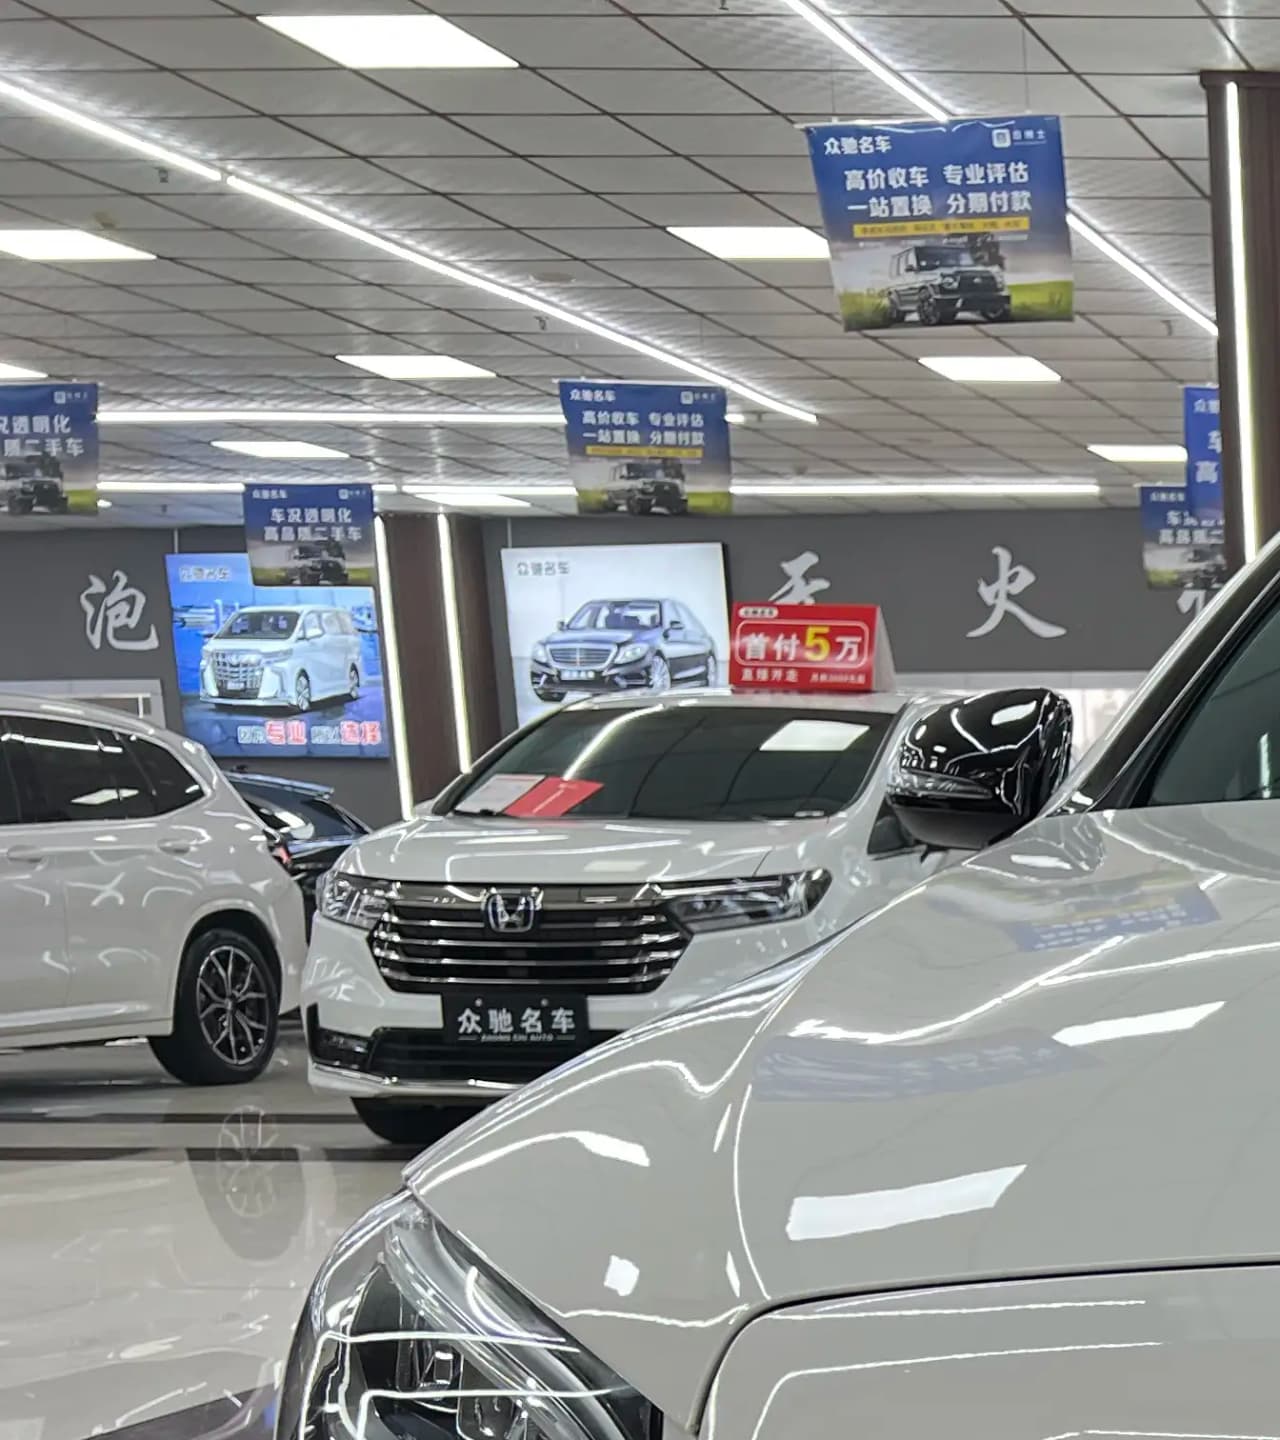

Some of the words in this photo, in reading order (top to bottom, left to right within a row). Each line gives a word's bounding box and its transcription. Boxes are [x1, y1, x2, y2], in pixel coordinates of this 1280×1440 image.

[824, 135, 892, 155] 众驰名车
[844, 166, 930, 191] 高价收车
[943, 162, 1029, 186] 专业评估
[848, 194, 934, 218] 一站置换
[946, 190, 1032, 215] 分期付款
[741, 625, 863, 662] 首付5万
[457, 1007, 576, 1034] 众驰名车
